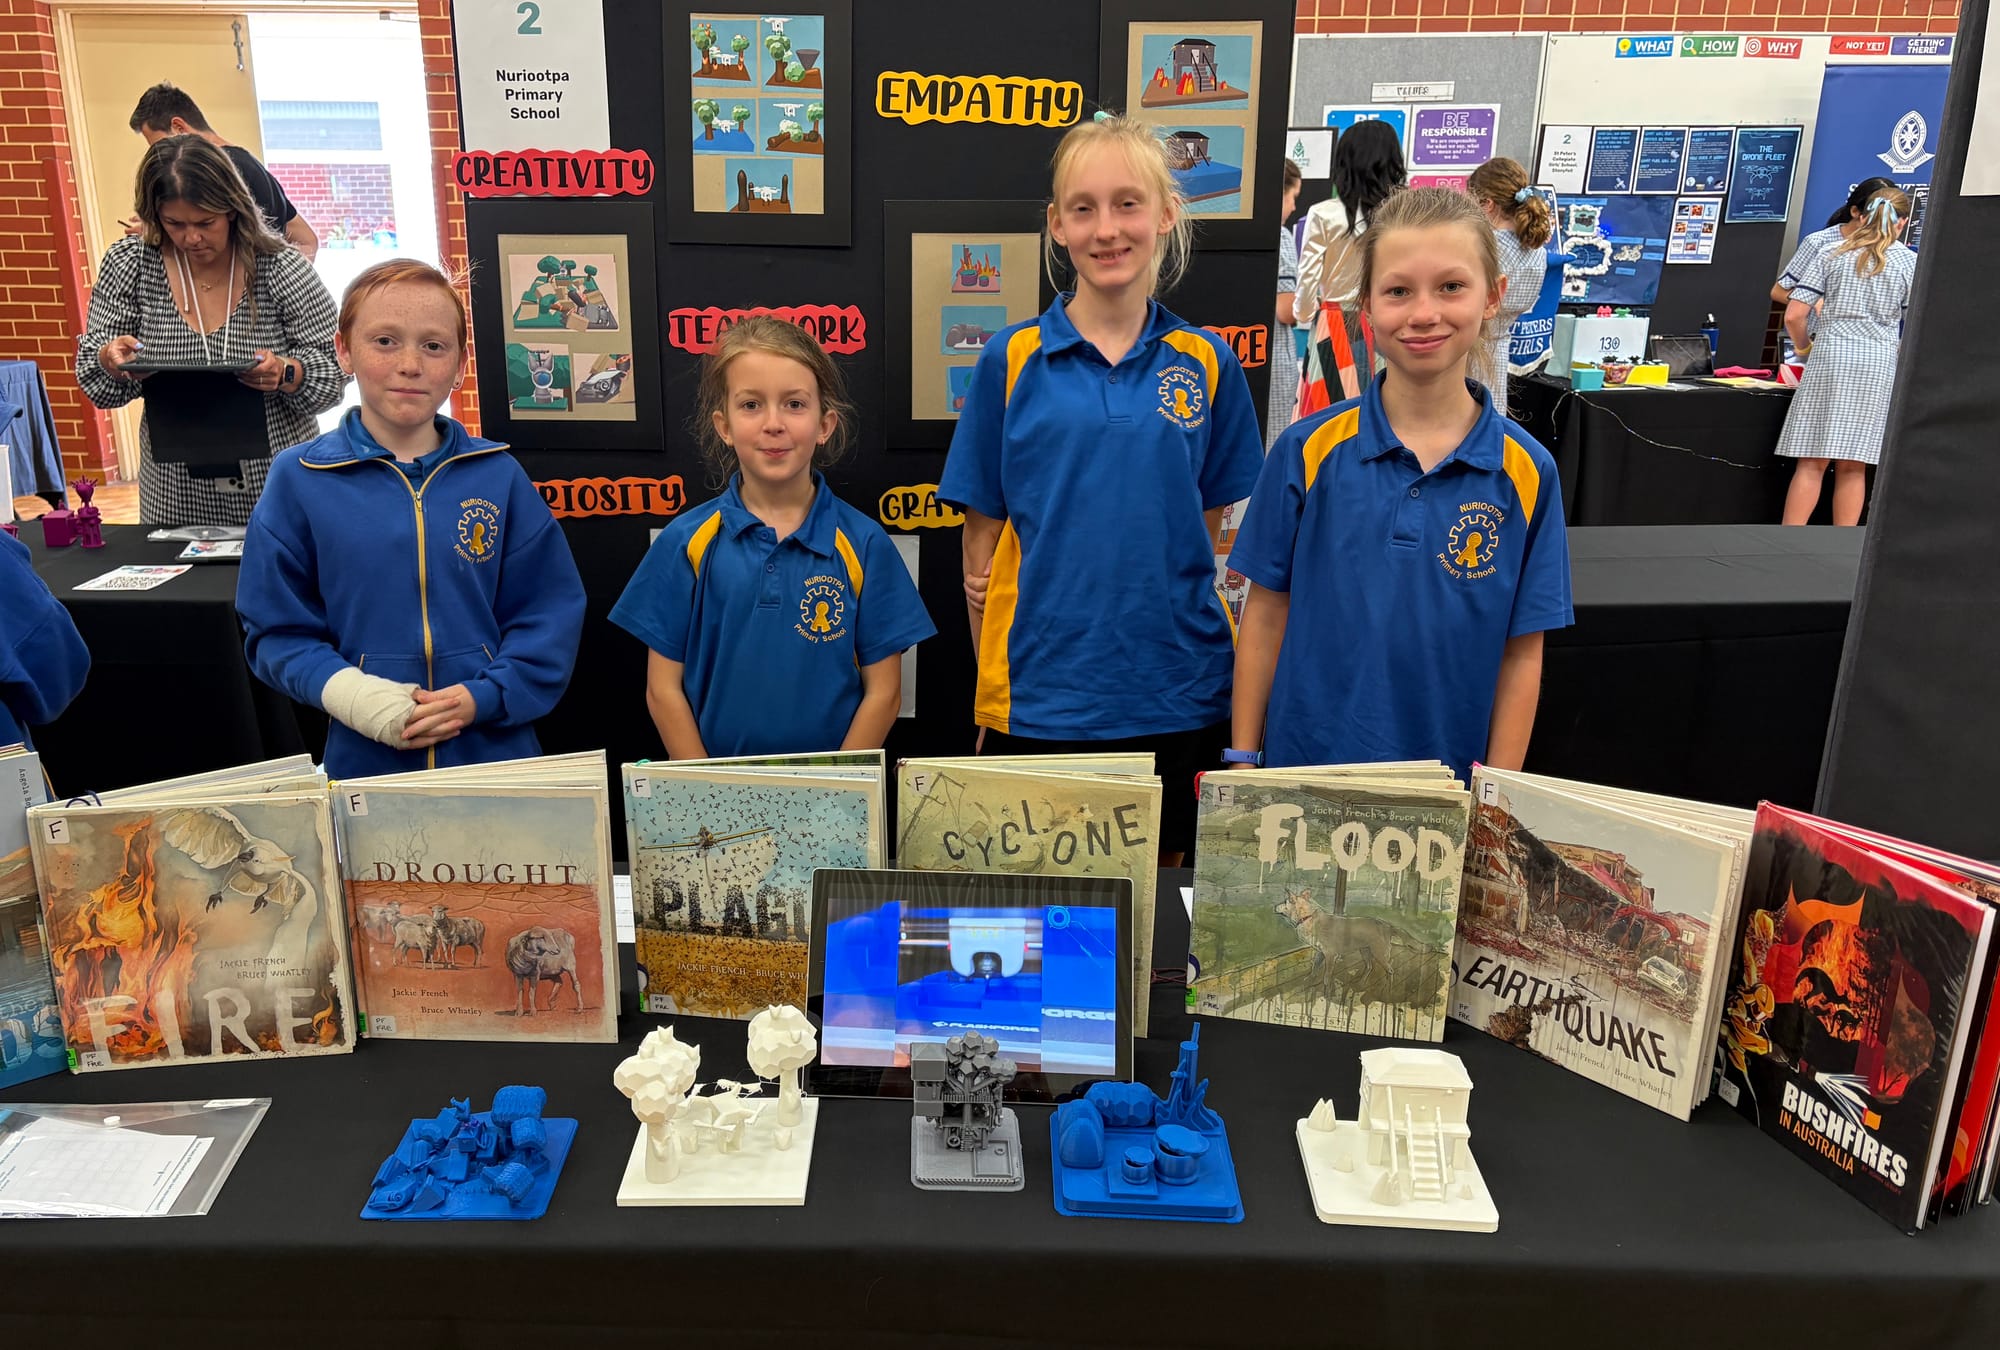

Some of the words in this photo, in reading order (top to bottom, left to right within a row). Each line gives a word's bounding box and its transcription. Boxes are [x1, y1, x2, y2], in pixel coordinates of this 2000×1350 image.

[517, 2, 542, 35] 2
[1635, 40, 1673, 51] WHAT
[1702, 40, 1736, 51] HOW
[1768, 42, 1798, 53] WHY
[1846, 41, 1864, 49] NOT
[1866, 42, 1885, 51] YET!
[1907, 46, 1938, 54] THERE!
[1908, 39, 1945, 47] GETTING
[496, 69, 569, 86] Nuriootpa
[505, 88, 563, 103] Primary
[882, 78, 1080, 124] EMPATHY
[510, 106, 560, 120] School
[1442, 112, 1469, 128] BE
[1421, 128, 1488, 137] RESPONSIBLE
[1562, 134, 1571, 144] 2
[1741, 153, 1764, 161] DRONE
[1759, 145, 1774, 153] THE
[456, 158, 651, 191] CREATIVITY
[670, 315, 861, 344] TEAORK
[1520, 318, 1553, 335] PETERS
[1215, 329, 1265, 363] CE
[1509, 337, 1544, 355] GIRLS
[460, 498, 501, 516] NURIOOTPA
[882, 491, 960, 520] GRA
[1459, 501, 1505, 524] NURIOOTPA
[1436, 553, 1463, 579] Primary
[1466, 565, 1497, 579] School
[804, 575, 845, 591] NURIOOTPA
[794, 623, 819, 644] Primary
[822, 627, 847, 642] School
[19, 768, 29, 795] Angela
[634, 778, 647, 792] F
[914, 775, 925, 791] F
[1217, 785, 1231, 802] F
[1484, 782, 1494, 799] F
[350, 793, 361, 812] F
[1311, 805, 1341, 816] Jackie
[1346, 807, 1377, 820] French
[1389, 810, 1416, 822] Bruce
[48, 820, 62, 839] F
[943, 799, 1148, 866] CYCLONE
[1255, 803, 1460, 882] FLOOD
[373, 862, 577, 885] DROUGHT
[220, 959, 248, 968] JACKIE
[253, 957, 286, 968] FRENCH
[677, 962, 707, 972] JACKIE
[710, 965, 746, 976] FRENCH
[756, 969, 785, 979] BRUCE
[237, 971, 265, 979] BRUCE
[270, 968, 312, 977] WHATLEY
[392, 988, 417, 998] Jackie
[421, 989, 449, 997] French
[421, 1006, 444, 1014] Bruce
[447, 1006, 482, 1016] Whatley
[1462, 956, 1676, 1078] EARTHQUAKE
[79, 987, 316, 1056] FIRE
[948, 1022, 1040, 1033] FLASHFORGE
[1285, 1013, 1355, 1028] SCHOLASTIC
[1555, 1042, 1578, 1057] Jackie
[1580, 1052, 1605, 1070] French
[1614, 1068, 1638, 1084] Bruce
[1639, 1078, 1672, 1100] Whatley
[1782, 1080, 1908, 1187] BUSHFIRES
[1779, 1109, 1792, 1130] IN
[1792, 1119, 1854, 1176] AUSTRALIA
